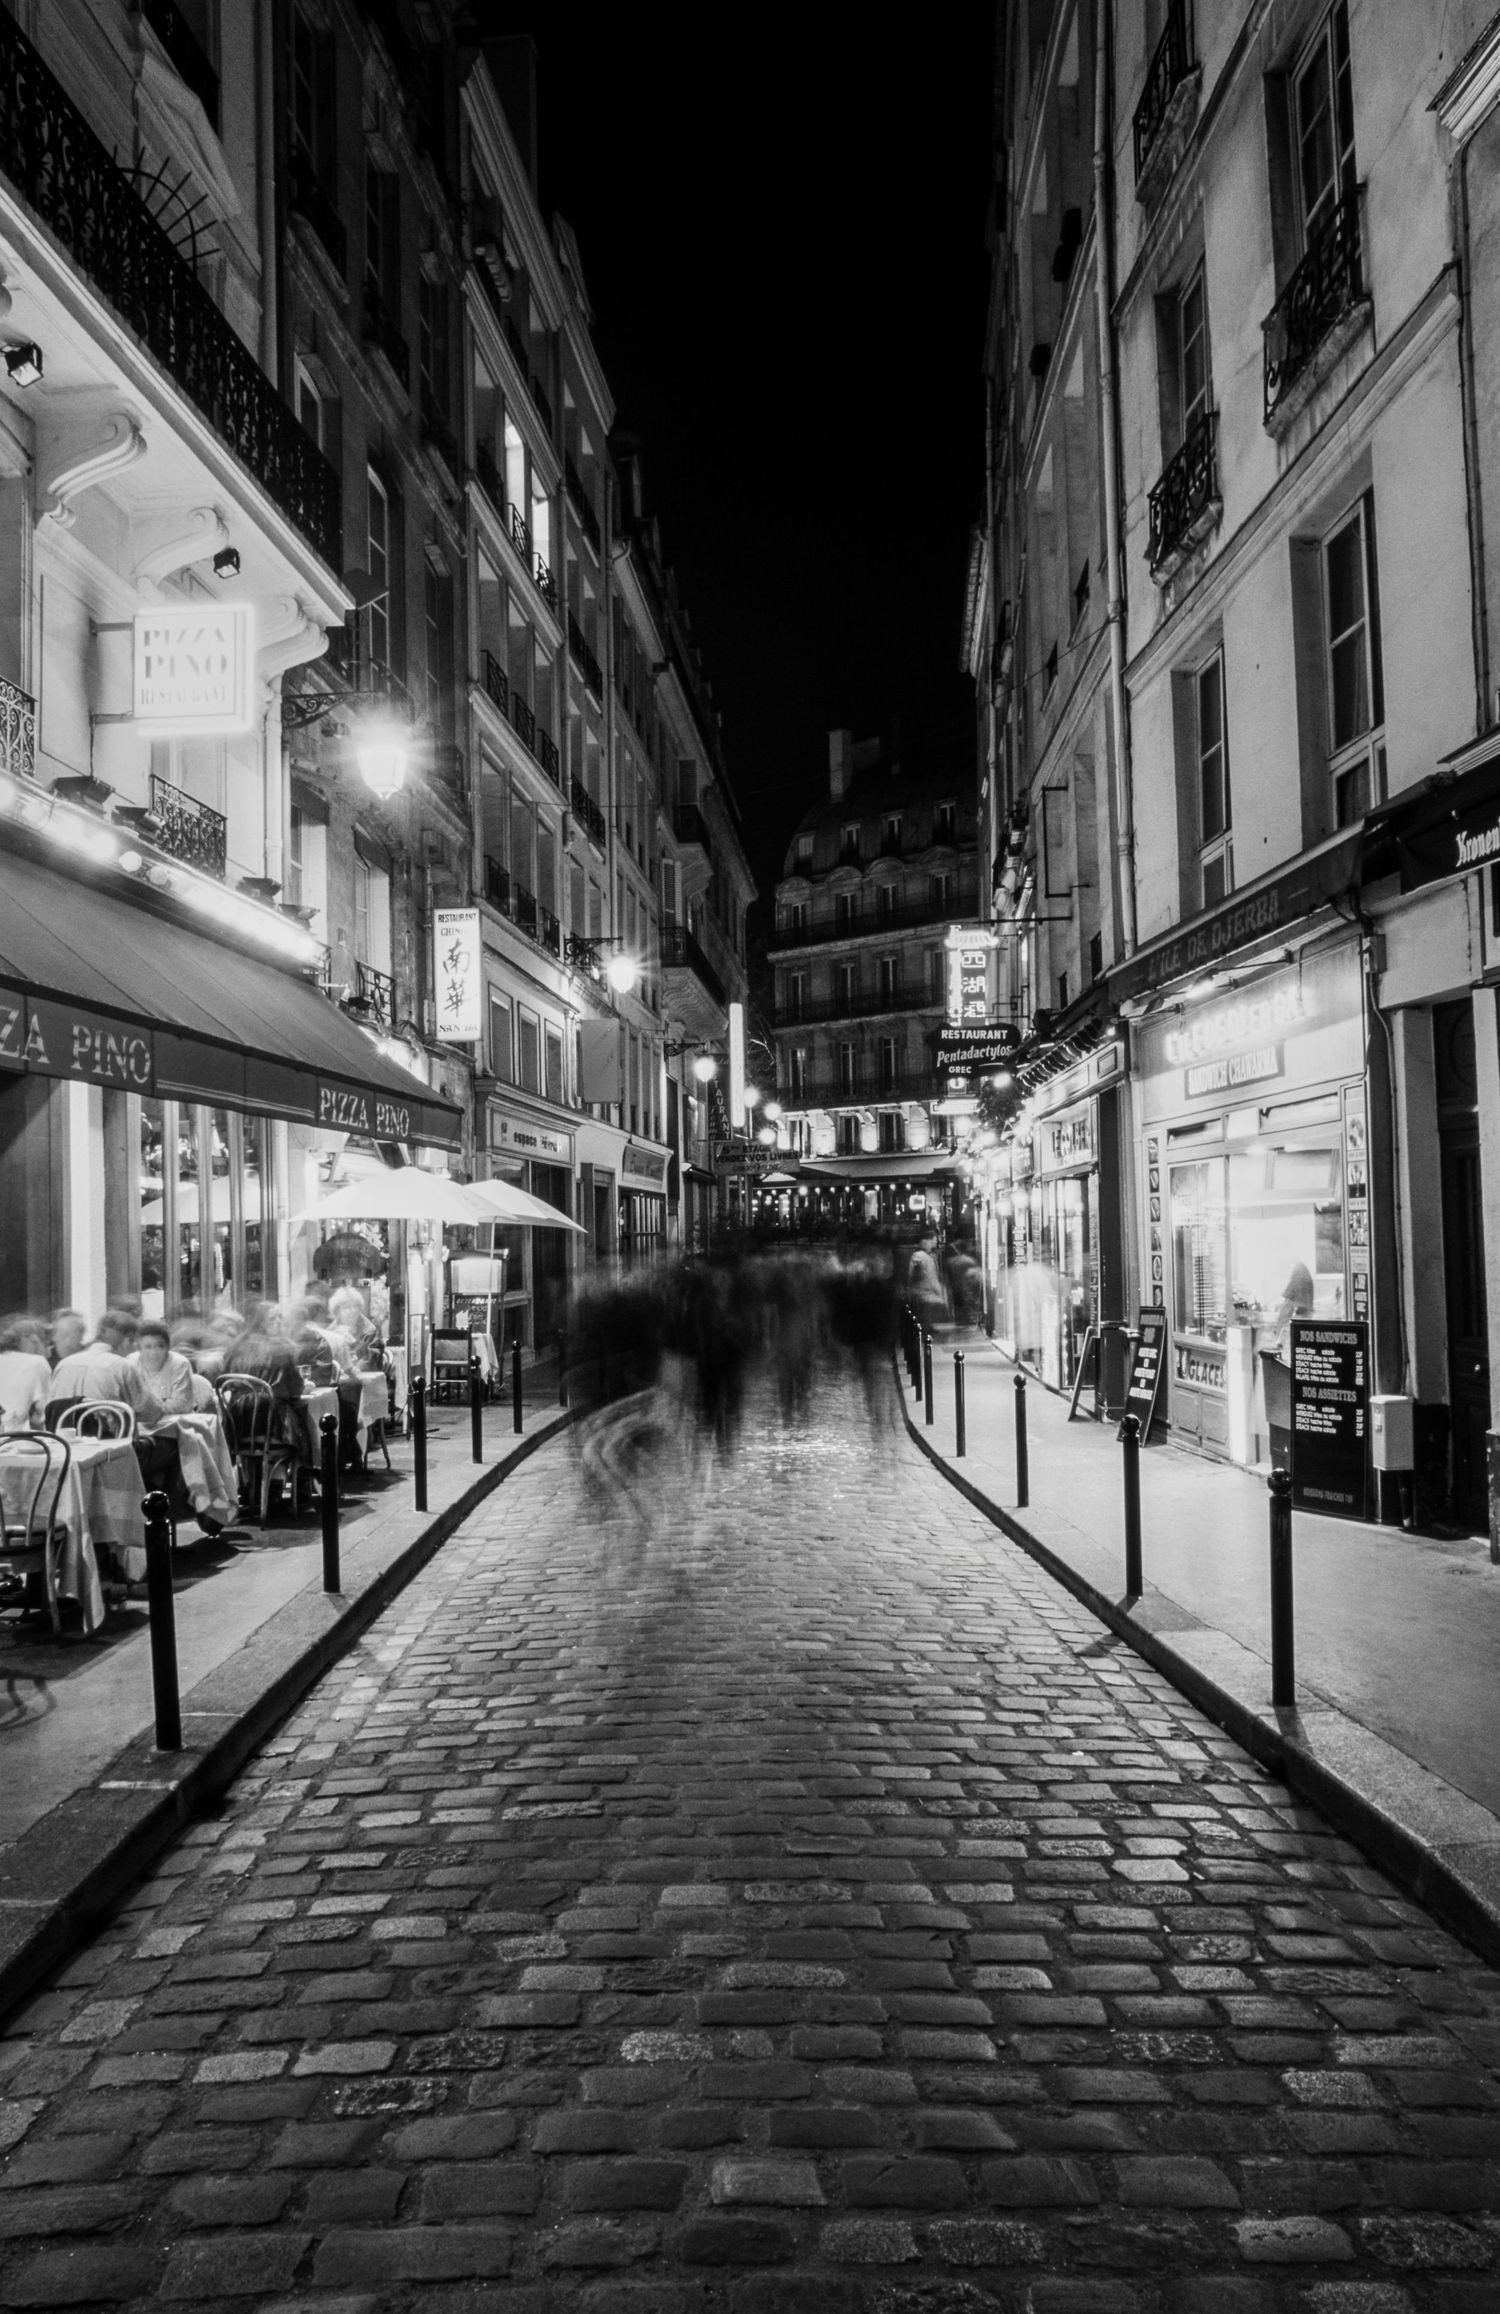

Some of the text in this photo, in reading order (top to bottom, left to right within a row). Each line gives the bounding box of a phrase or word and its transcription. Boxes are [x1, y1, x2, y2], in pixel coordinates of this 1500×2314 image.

[143, 626, 225, 647] PIZZA
[145, 653, 228, 679] PINO
[438, 913, 477, 923] RESTAURANT
[1187, 930, 1208, 963] DE
[1211, 889, 1280, 950] DJERBA
[941, 1029, 1008, 1040] RESTAURANT
[71, 1023, 150, 1083] PINO
[936, 1044, 1013, 1068] Pentadactylos
[948, 1065, 972, 1074] GREC
[320, 1087, 410, 1138] PIZZA PINO
[513, 1131, 537, 1148] espace
[749, 1153, 767, 1162] VOS
[769, 1151, 799, 1161] LIVRES
[1300, 1330, 1314, 1342] NOS
[1188, 1359, 1225, 1388] GLACES
[1302, 1386, 1357, 1402] NOS ASSIETTES
